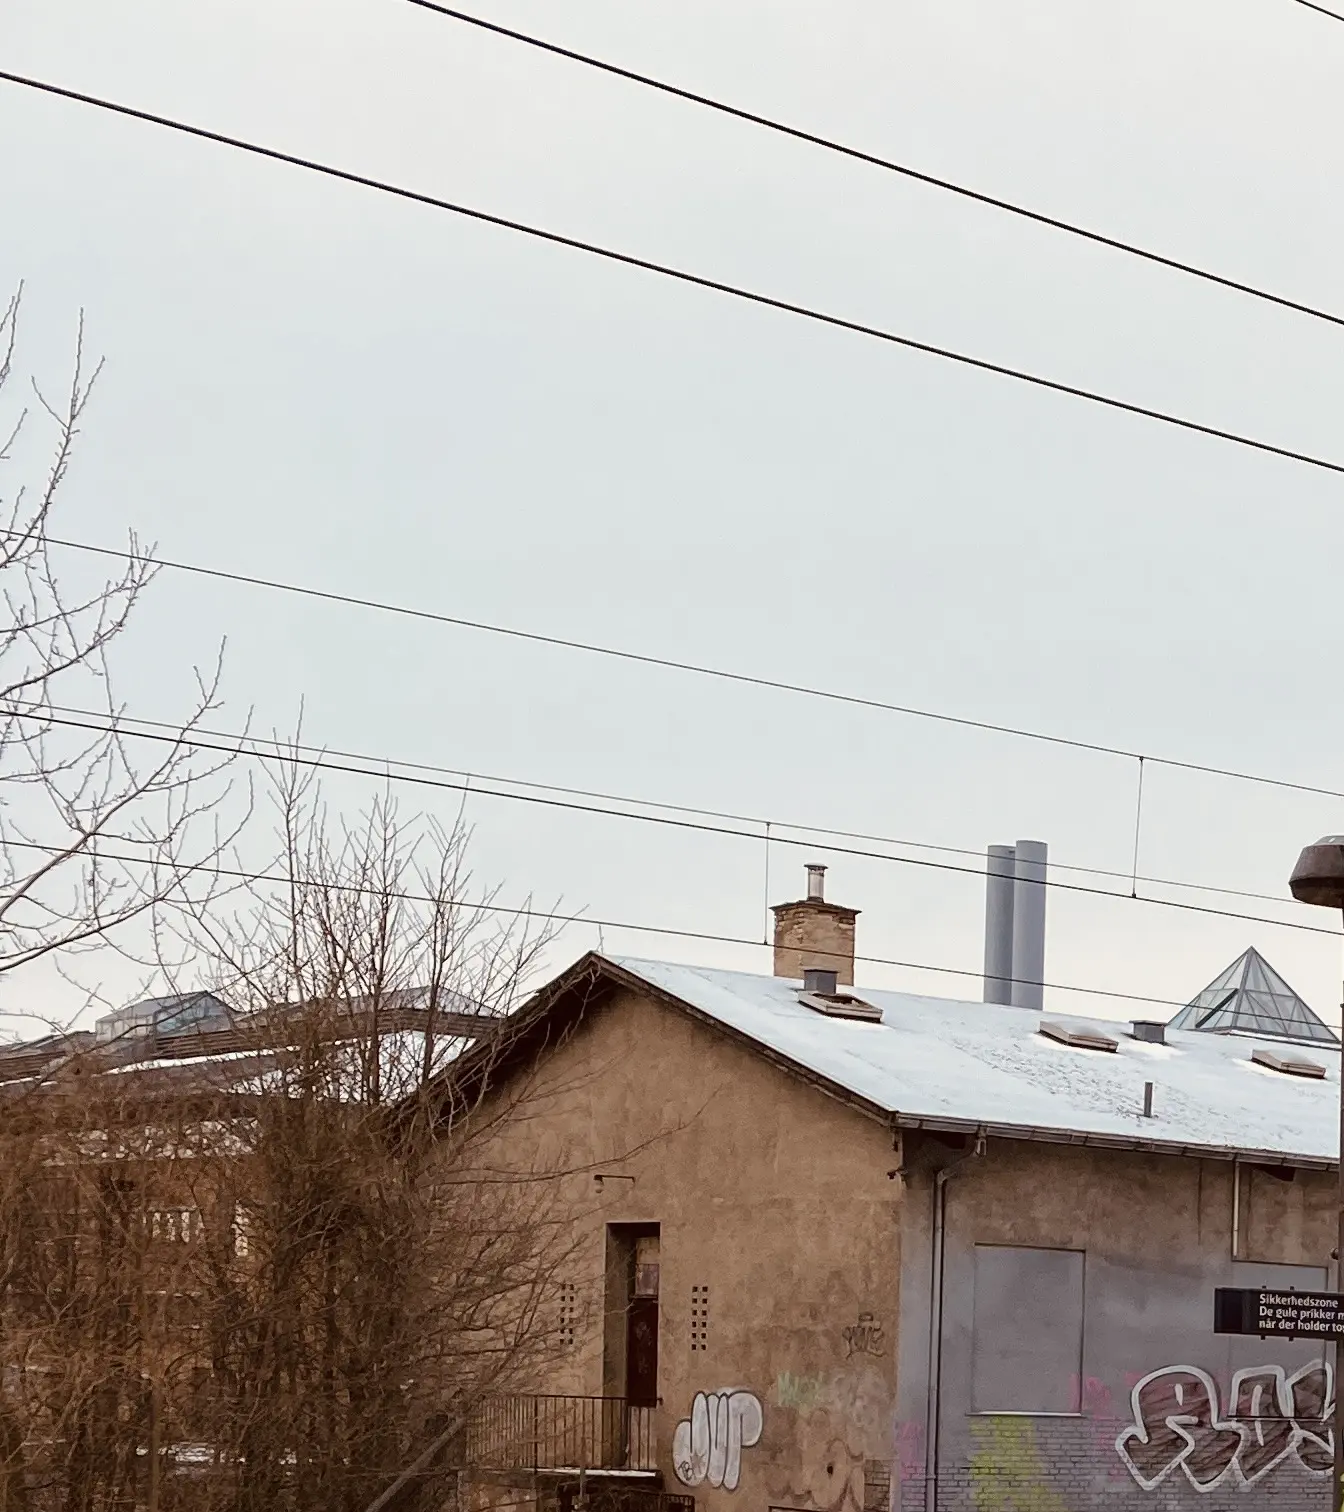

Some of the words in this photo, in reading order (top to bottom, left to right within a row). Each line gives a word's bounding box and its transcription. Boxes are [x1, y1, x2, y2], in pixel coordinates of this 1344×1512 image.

[1259, 1293, 1339, 1308] Sikkerhedszone
[1259, 1306, 1273, 1317] De
[1275, 1307, 1298, 1320] gule
[1300, 1308, 1336, 1321] prikker
[1259, 1318, 1276, 1329] når
[1278, 1319, 1295, 1330] der
[1297, 1320, 1330, 1332] holder
